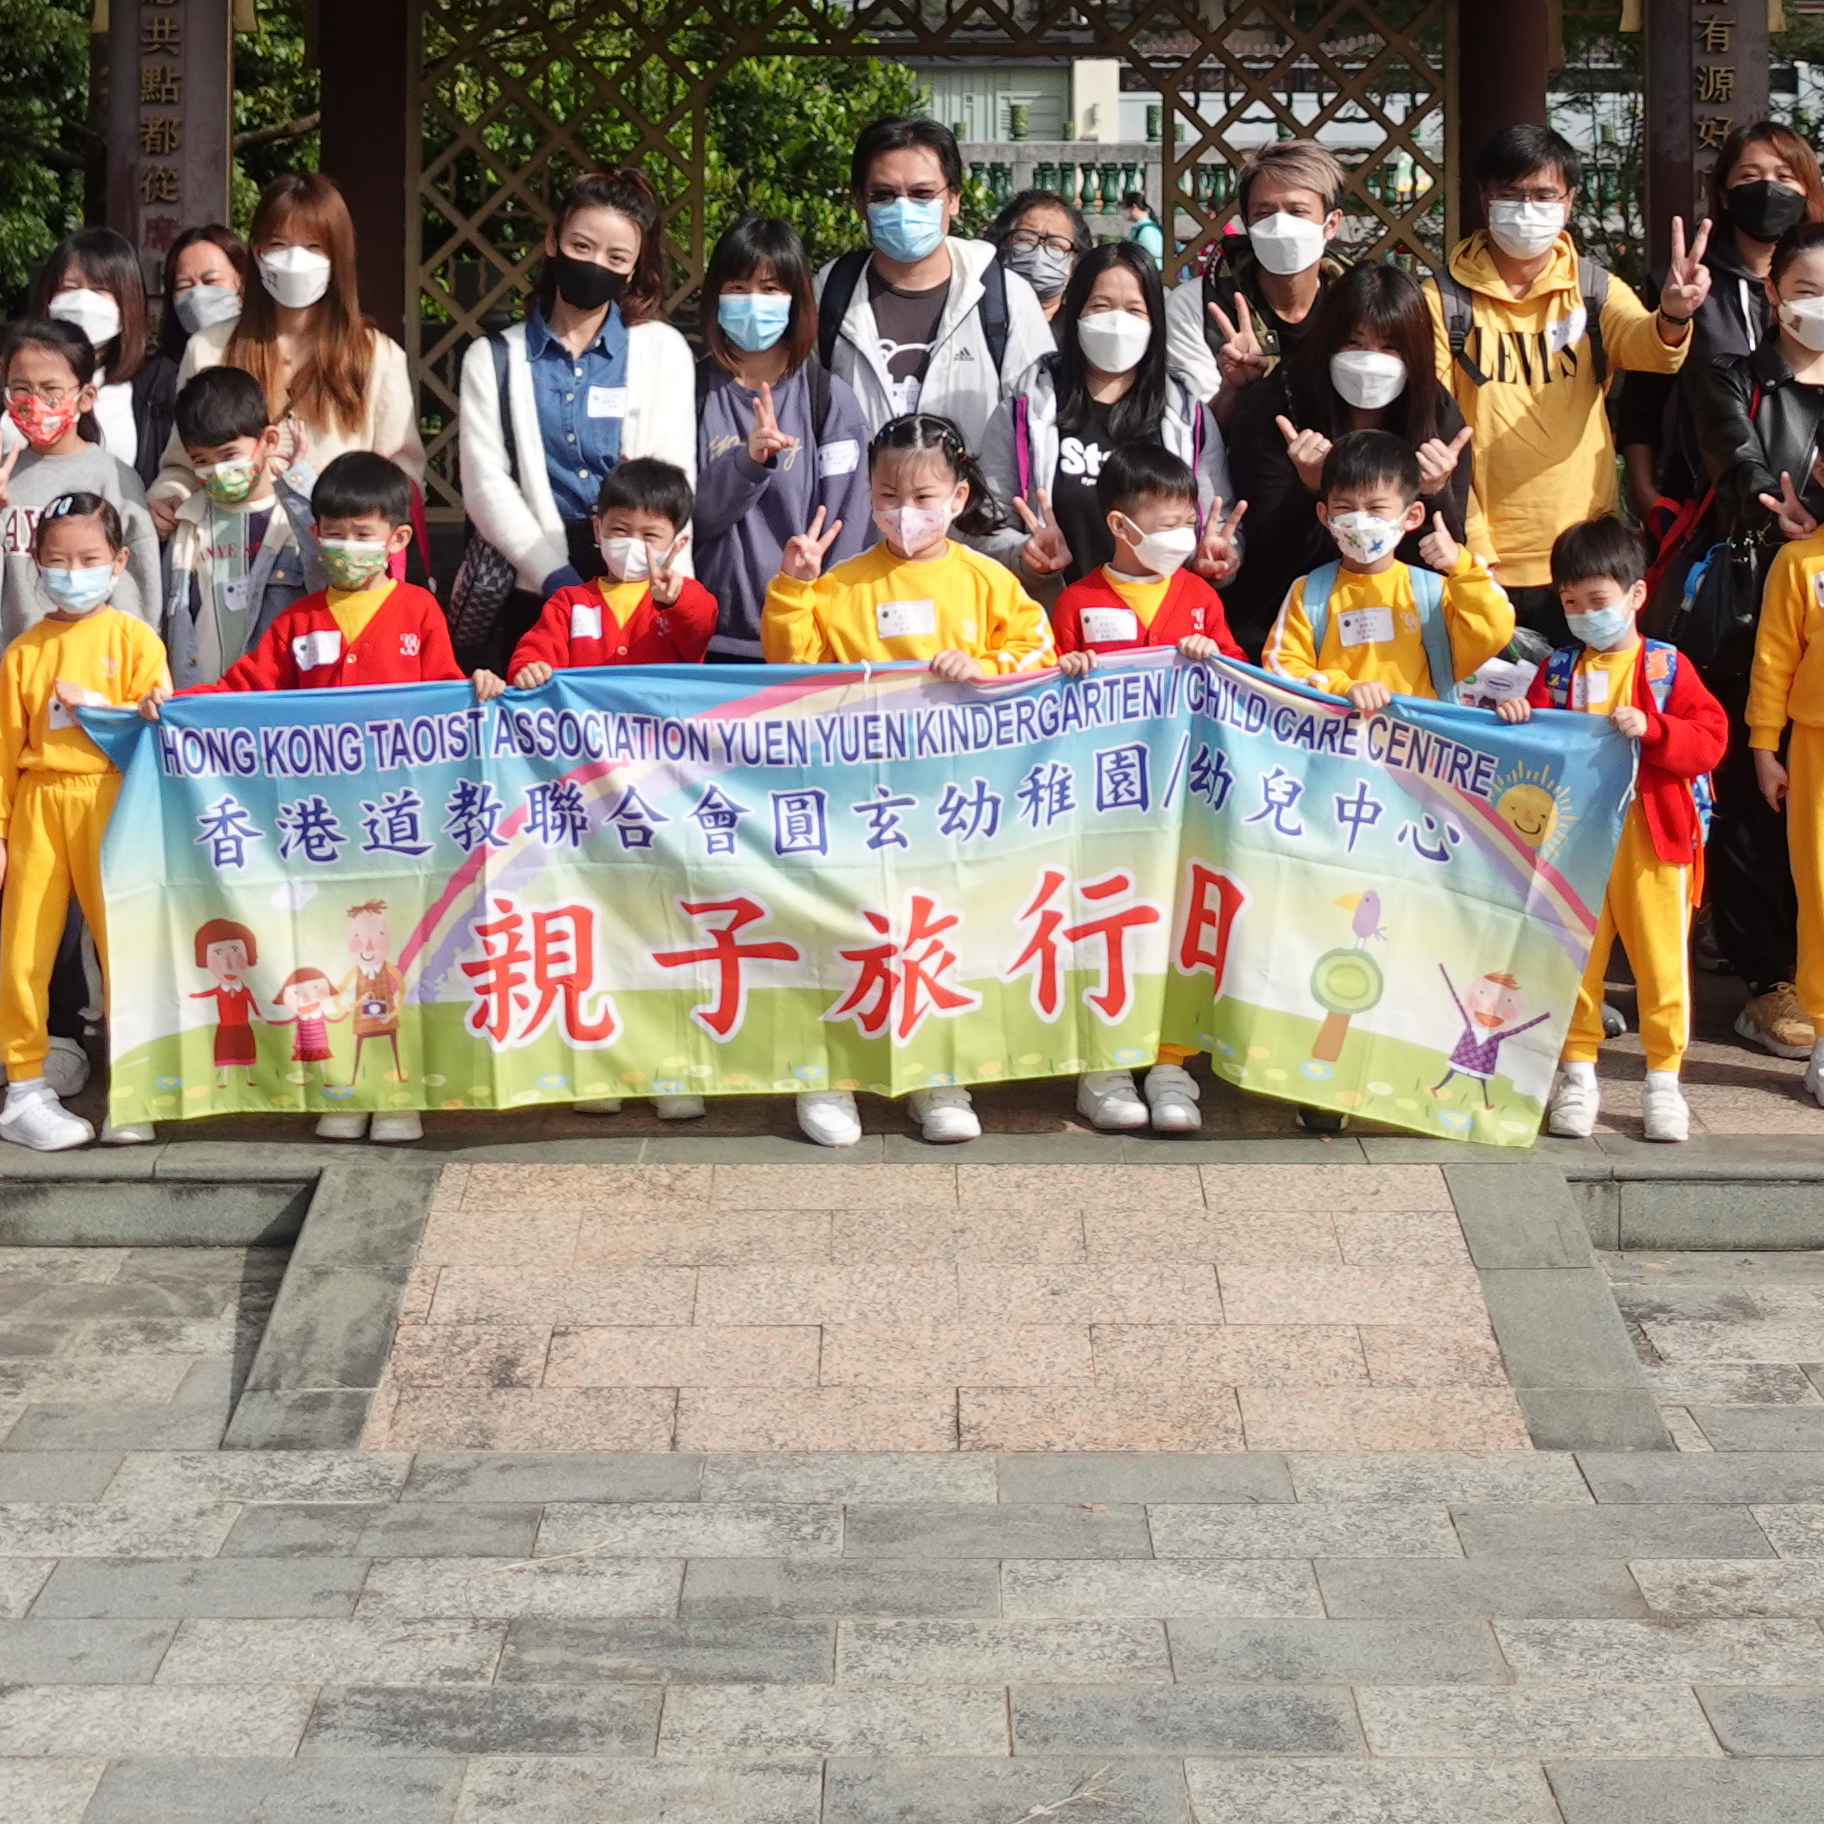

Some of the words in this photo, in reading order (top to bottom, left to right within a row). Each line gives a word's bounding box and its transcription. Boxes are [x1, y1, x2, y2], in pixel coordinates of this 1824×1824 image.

[1060, 436, 1112, 477] St
[160, 725, 258, 778] HONG
[261, 722, 365, 776] KONG
[367, 707, 488, 770] TAOIST
[490, 707, 711, 763] ASSOCIATION
[716, 717, 812, 767] YUEN
[815, 709, 910, 767] YUEN
[913, 668, 1164, 758] KINDERGARTEN
[1185, 664, 1270, 737] CHILD
[1273, 706, 1363, 760] CARE
[1365, 711, 1500, 800] CENTRE
[460, 861, 1247, 1043] 親子旅行日
